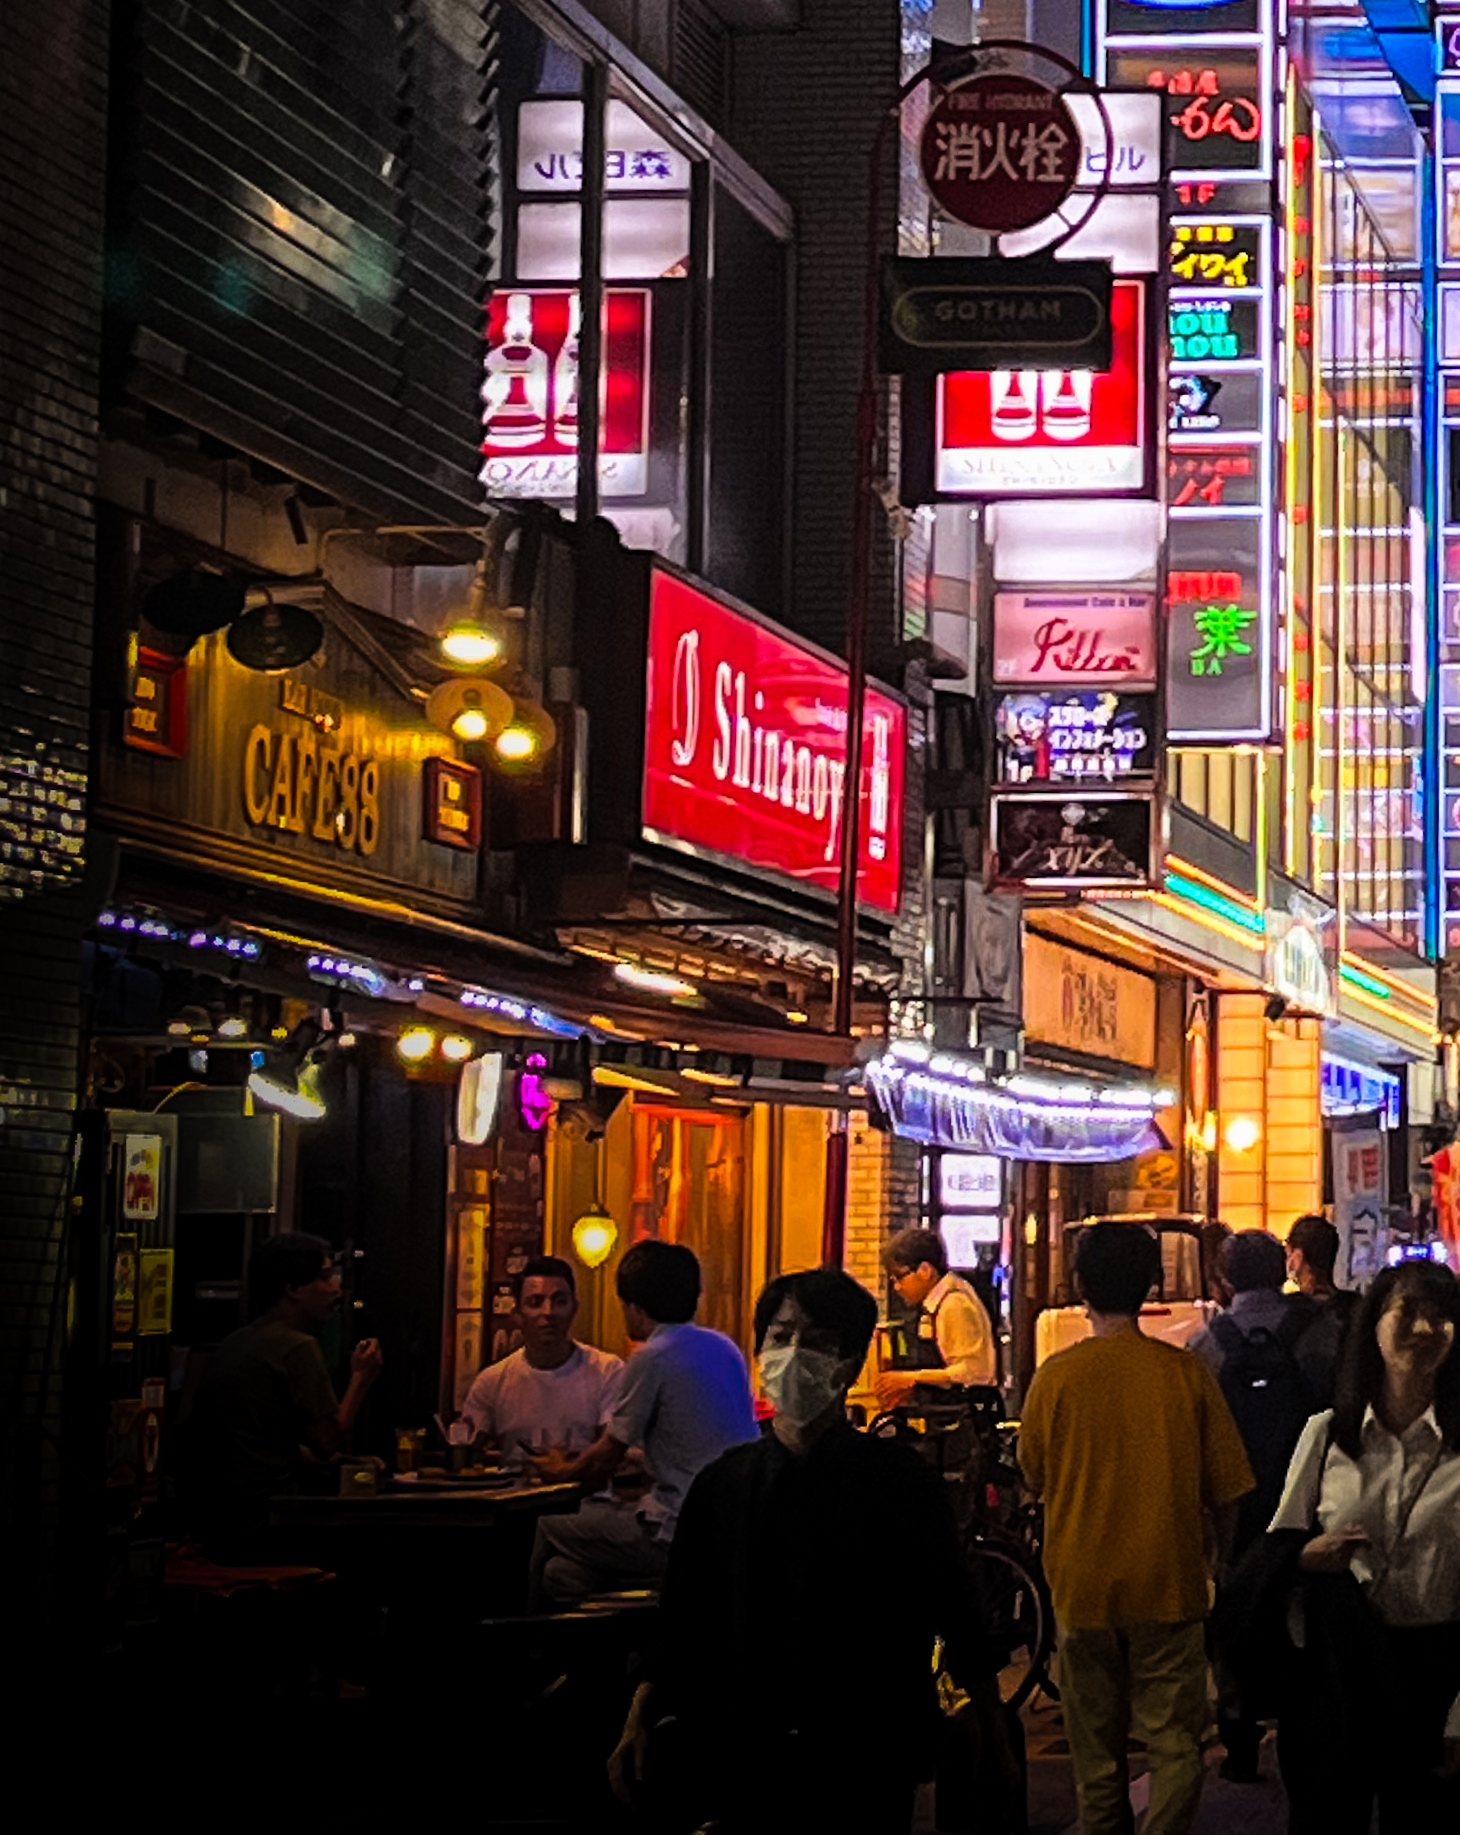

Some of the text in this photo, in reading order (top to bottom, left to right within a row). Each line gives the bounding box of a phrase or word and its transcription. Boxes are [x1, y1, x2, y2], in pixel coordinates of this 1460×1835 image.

[933, 121, 1069, 183] 消火栓
[933, 299, 1062, 322] GOTHAM
[713, 660, 868, 862] Shinanoy
